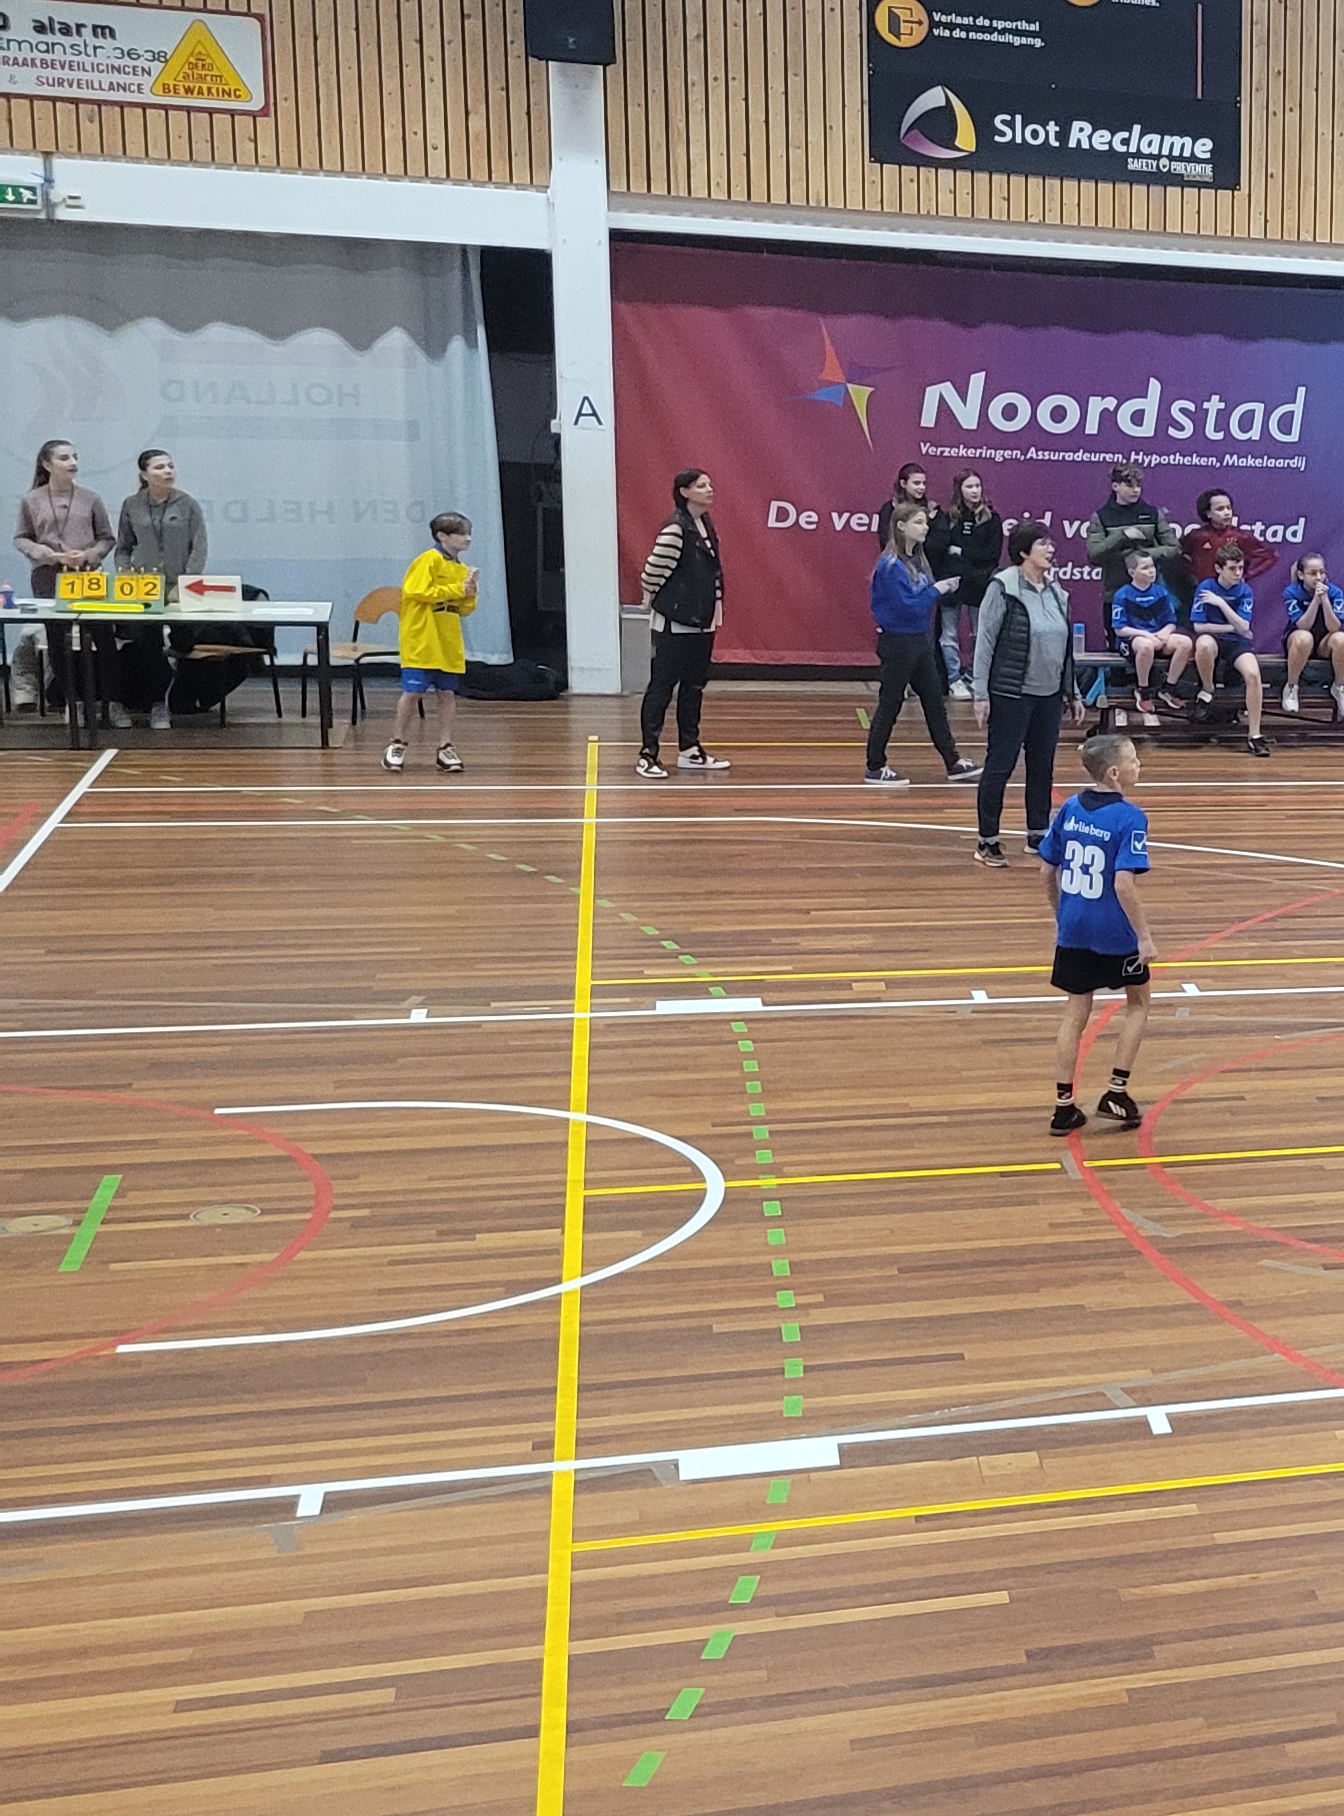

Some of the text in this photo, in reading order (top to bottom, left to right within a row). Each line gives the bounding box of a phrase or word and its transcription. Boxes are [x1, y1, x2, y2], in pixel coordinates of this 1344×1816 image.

[32, 16, 116, 41] alarm
[932, 12, 1040, 33] Verlaat de sporthal
[932, 27, 1045, 47] via de nooduitgang.
[35, 75, 145, 94] SURVEILLANCE
[182, 71, 224, 83] alarm
[162, 83, 242, 99] BEWAKING
[993, 114, 1214, 159] Slot Reclame
[1127, 157, 1158, 170] SAFETY
[574, 396, 603, 428] A
[920, 371, 1306, 443] Noordstad
[920, 442, 1306, 471] Verzekeringen, Assuradeuren, Hypotheken, Makelaardij
[767, 500, 819, 531] De
[1061, 840, 1105, 899] 33
